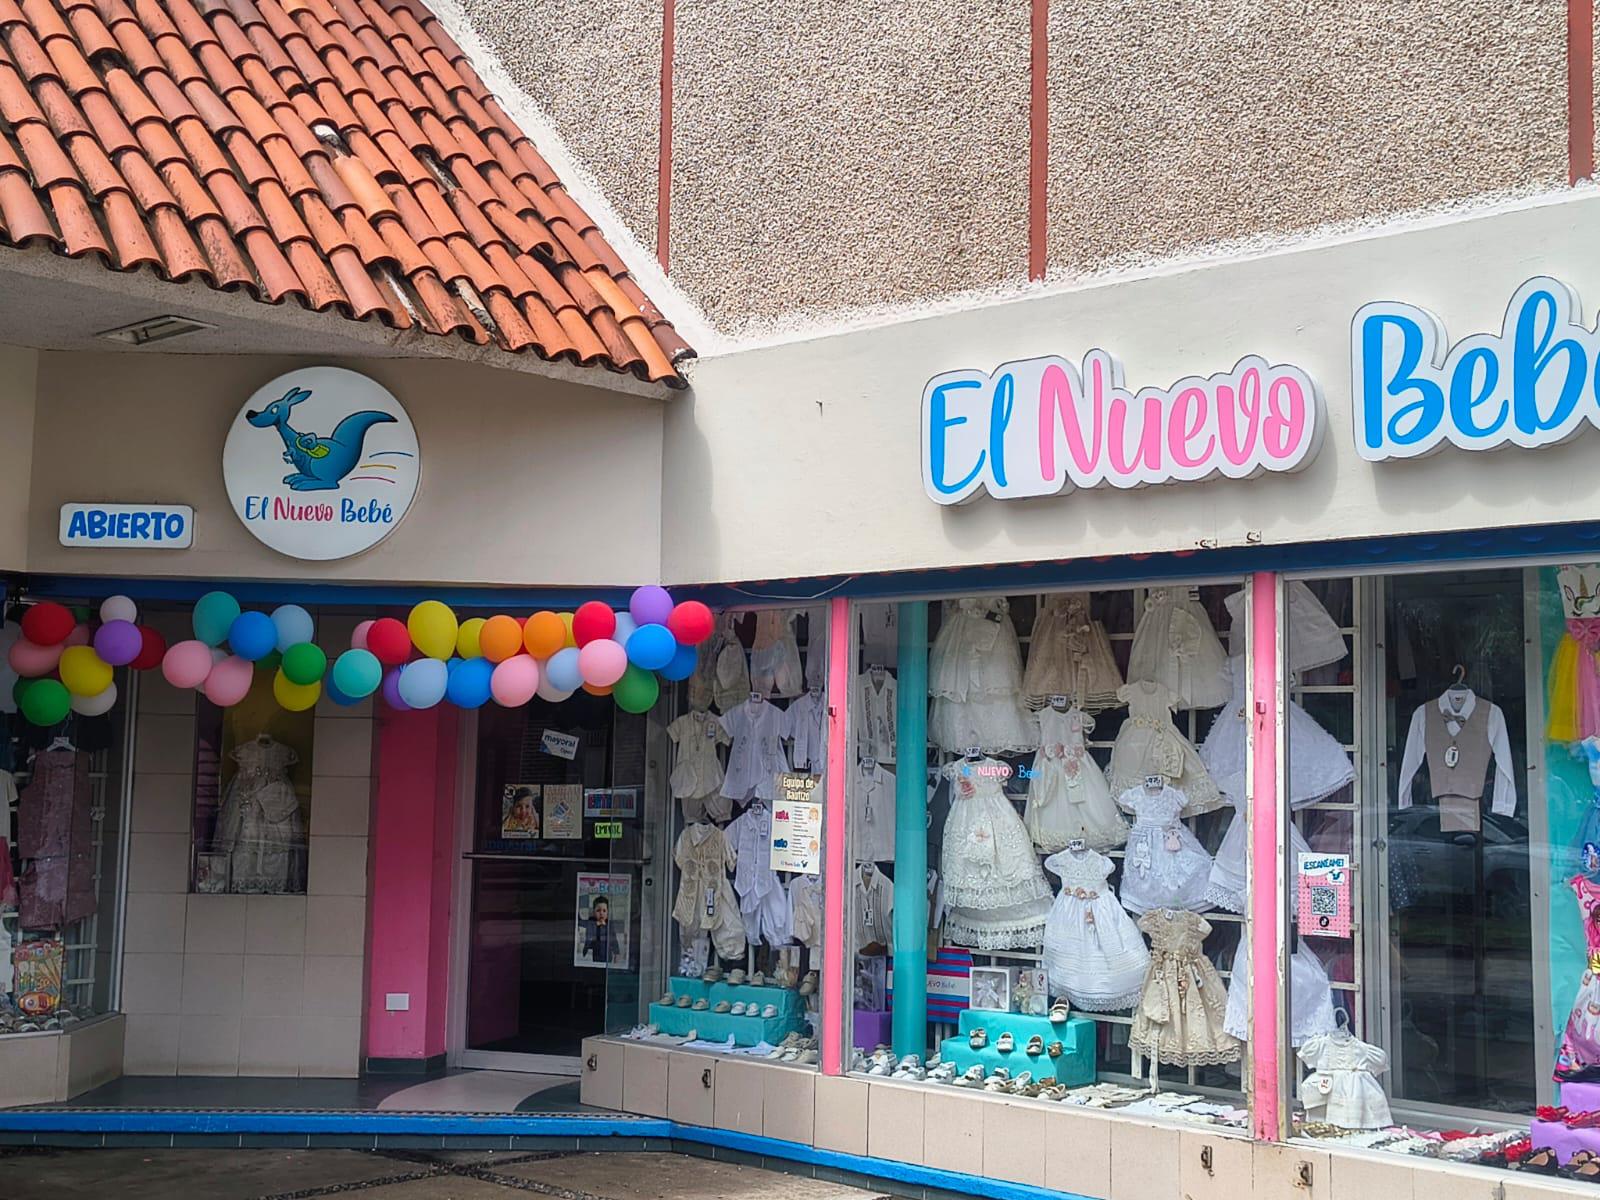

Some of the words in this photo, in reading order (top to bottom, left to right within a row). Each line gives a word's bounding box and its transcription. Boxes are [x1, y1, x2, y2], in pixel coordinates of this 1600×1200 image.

[929, 372, 1015, 496] El
[1038, 357, 1306, 483] Nuevo
[1361, 289, 1600, 450] Beb
[245, 495, 271, 522] El
[273, 496, 334, 523] Nuevo
[340, 497, 394, 525] Bebé
[67, 509, 185, 542] ABIERTO
[544, 734, 576, 747] mayoral
[977, 765, 1010, 777] NUEVO
[805, 777, 814, 789] de
[786, 789, 810, 801] Bautizo
